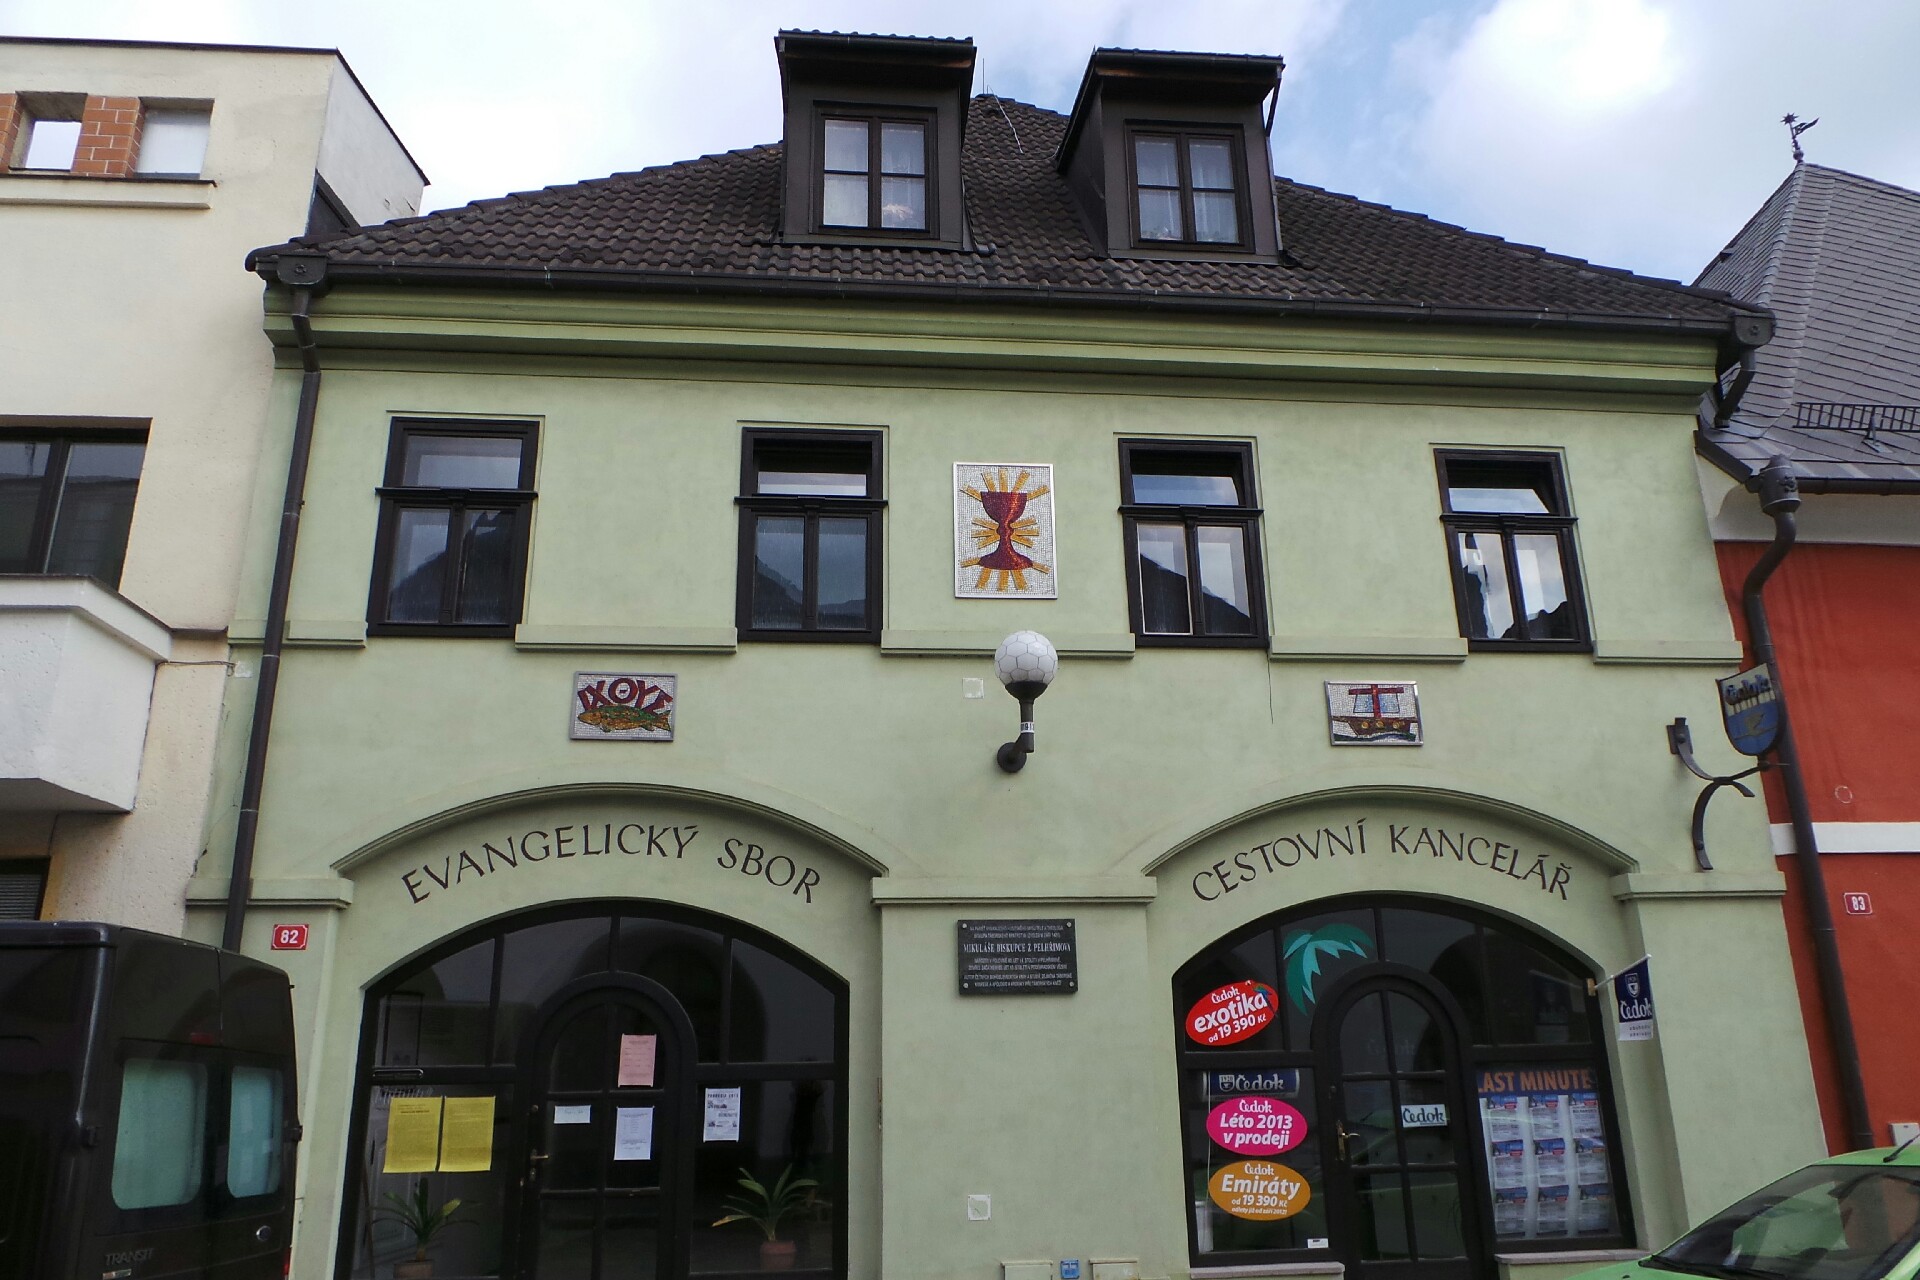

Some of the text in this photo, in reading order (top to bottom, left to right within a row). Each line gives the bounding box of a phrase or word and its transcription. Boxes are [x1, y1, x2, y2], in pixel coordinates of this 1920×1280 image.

[401, 823, 820, 904] EVANGELICKÝ SBOR
[1192, 817, 1571, 901] CESTOVNÍ KANCELÁŘ
[1851, 896, 1866, 911] 83
[280, 929, 299, 944] 82
[963, 941, 995, 953] MIKULÁŠE
[996, 943, 1026, 953] BISKUPCE
[1211, 986, 1240, 1004] Čedok
[1194, 993, 1268, 1033] exotika
[1620, 998, 1652, 1020] Čedok
[1208, 1032, 1219, 1043] od
[1217, 1024, 1232, 1039] 19
[1232, 1014, 1256, 1034] 390
[1235, 1073, 1285, 1092] Čedok
[1519, 1069, 1592, 1091] MINUTE
[1239, 1099, 1273, 1114] Čedok
[1220, 1112, 1293, 1129] Léto 2013
[1223, 1129, 1290, 1150] v prodeji
[1244, 1162, 1275, 1176] Čedok
[1221, 1174, 1301, 1201] Emiráty
[1231, 1197, 1241, 1205] od
[1242, 1194, 1255, 1206] 19
[1255, 1195, 1278, 1207] 390
[105, 1248, 154, 1266] TRANSIT
